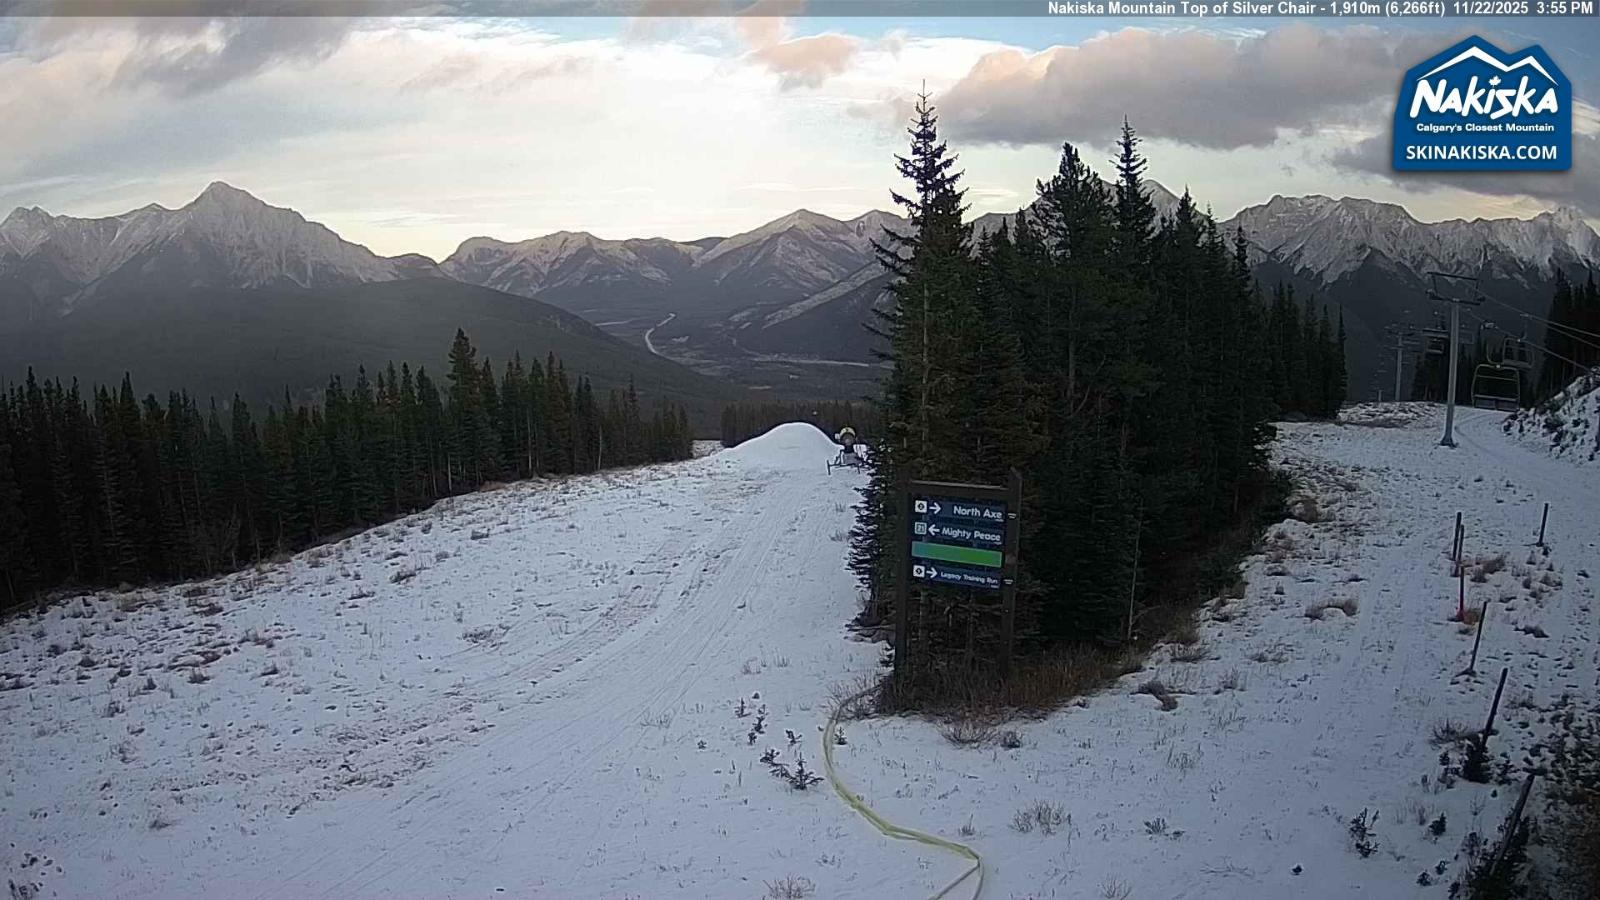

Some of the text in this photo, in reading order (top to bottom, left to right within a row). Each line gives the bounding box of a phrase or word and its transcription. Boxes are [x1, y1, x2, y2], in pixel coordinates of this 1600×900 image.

[953, 505, 981, 517] North
[983, 508, 1003, 519] Axe
[941, 527, 1001, 542] Mighty Peace
[940, 571, 962, 581] Legacy
[963, 574, 985, 584] Training
[986, 576, 998, 584] Run
